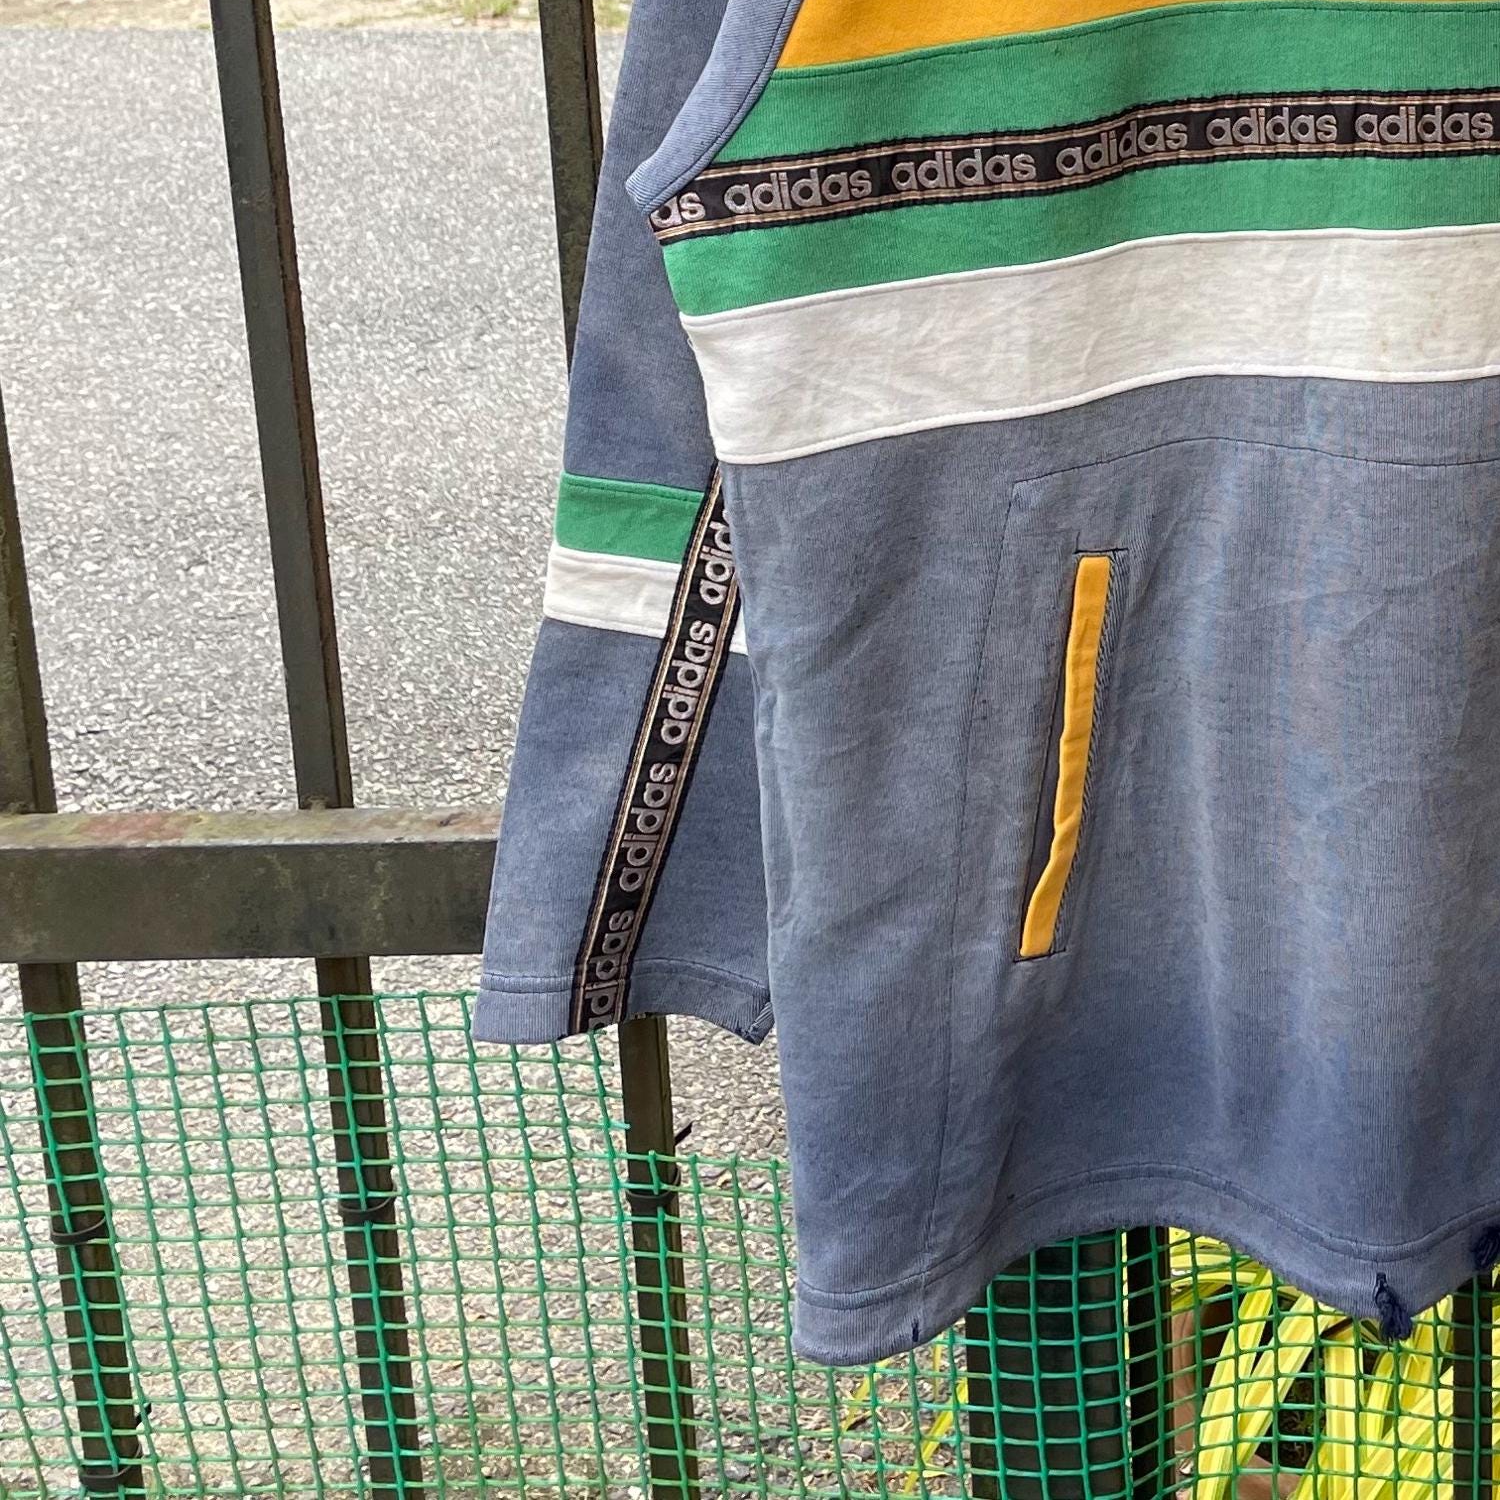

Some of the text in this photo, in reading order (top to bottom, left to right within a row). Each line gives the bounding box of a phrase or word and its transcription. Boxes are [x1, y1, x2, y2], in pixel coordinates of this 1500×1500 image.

[724, 168, 873, 215] adidas
[891, 148, 1037, 192] adidas
[1056, 121, 1189, 178] adidas
[1206, 106, 1338, 146] adidas
[1355, 105, 1494, 144] adidas
[619, 762, 678, 893] adidas
[660, 620, 718, 745] adidas
[699, 508, 735, 606] adid
